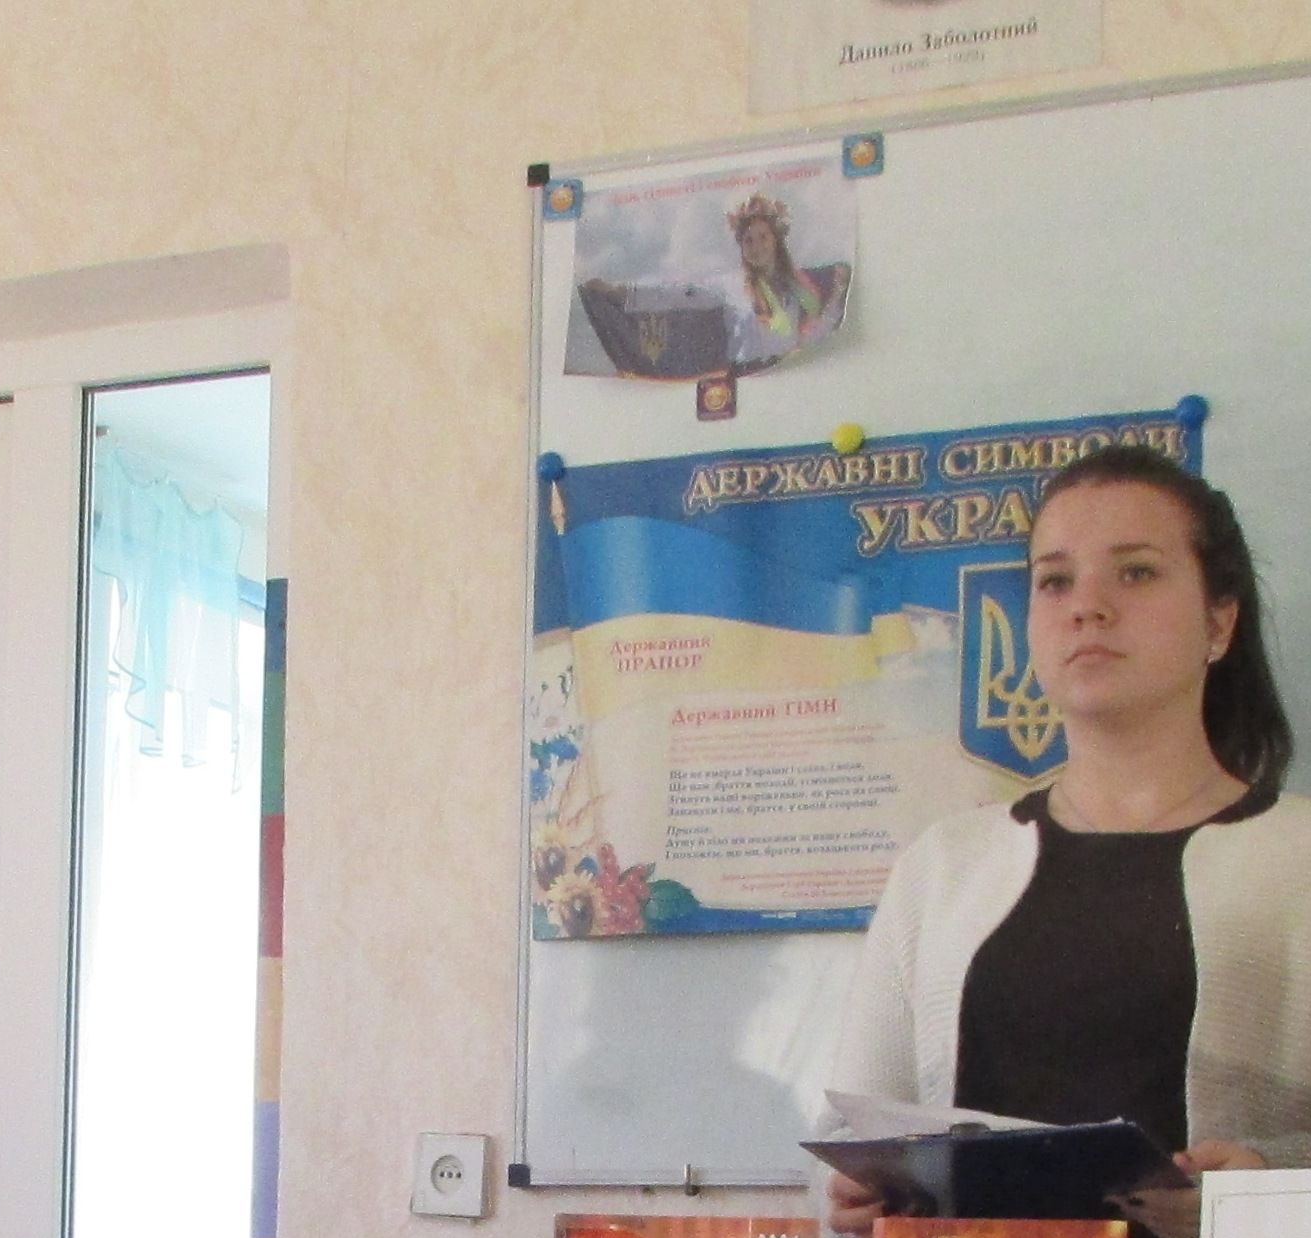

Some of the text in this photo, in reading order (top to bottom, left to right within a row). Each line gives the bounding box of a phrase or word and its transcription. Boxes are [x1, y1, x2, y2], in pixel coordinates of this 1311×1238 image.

[839, 16, 1038, 65] Данило Заболотний
[687, 450, 924, 510] ДЕРЖАВНІ
[854, 485, 1045, 552] УКРА
[616, 653, 703, 673] ПРАПОР
[671, 698, 838, 726] Державний ГІМН
